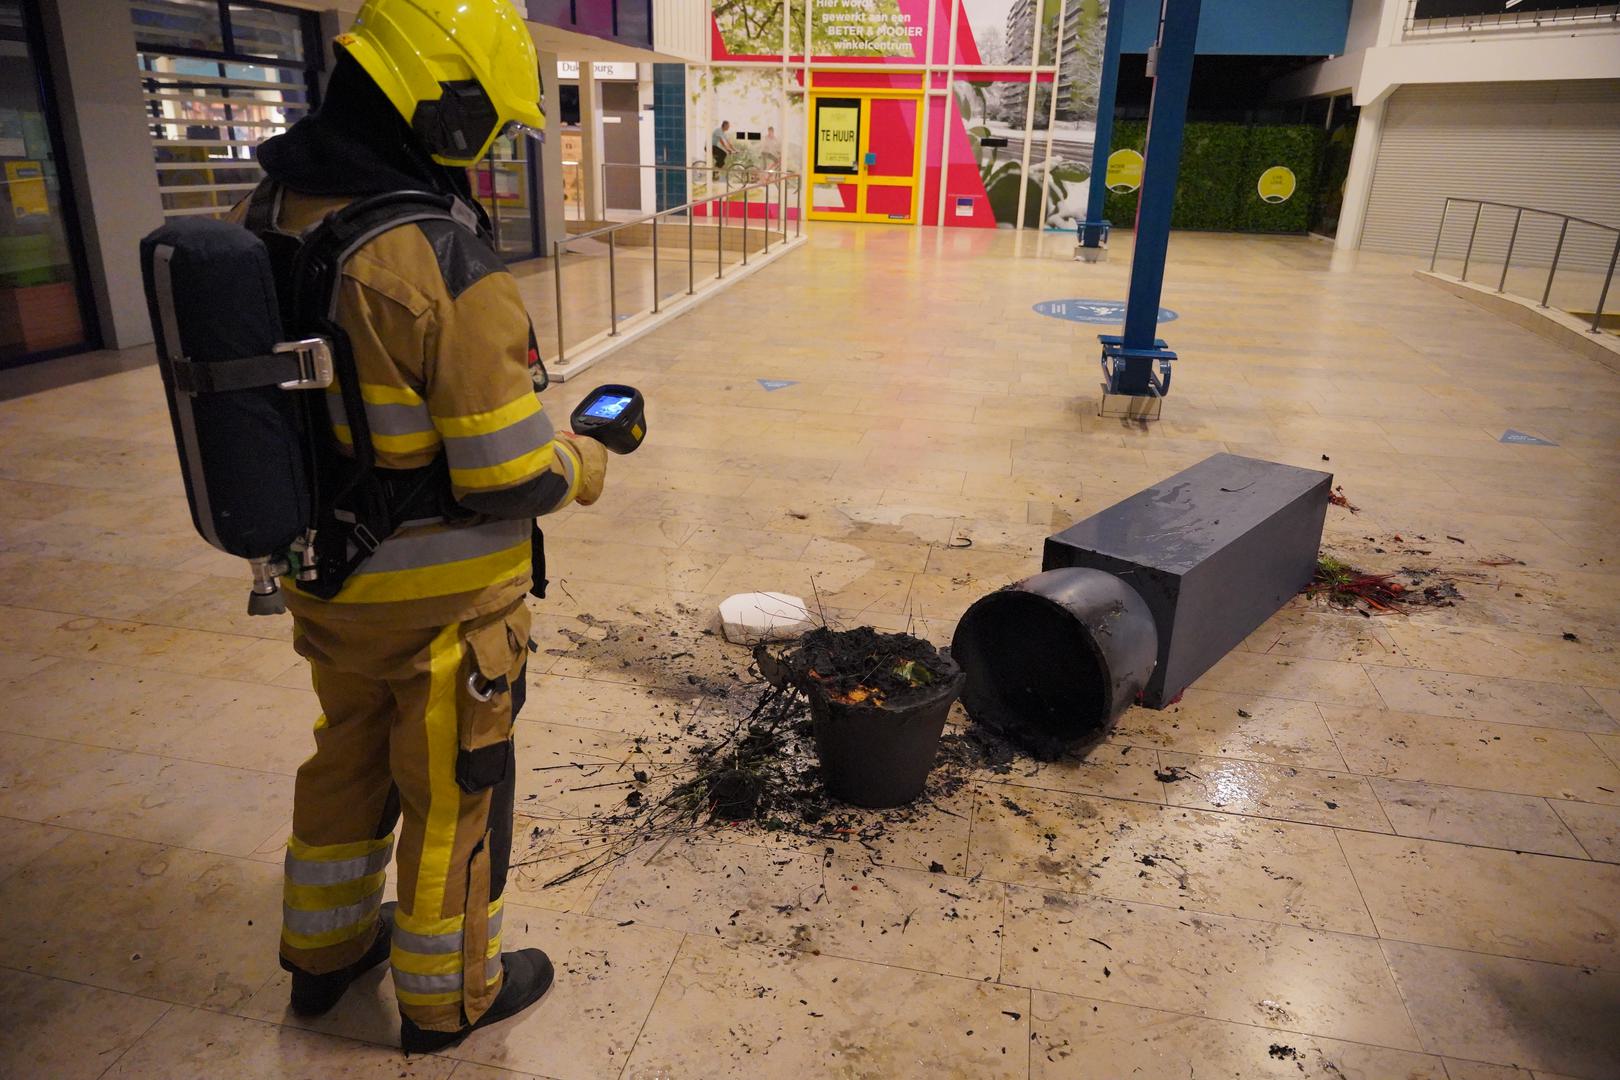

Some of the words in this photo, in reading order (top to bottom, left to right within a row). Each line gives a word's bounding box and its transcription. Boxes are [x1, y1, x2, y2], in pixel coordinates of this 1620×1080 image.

[822, 12, 866, 23] gewerkt
[868, 14, 888, 22] aan
[890, 14, 911, 22] een
[827, 26, 864, 36] BETER
[877, 26, 923, 37] MOOIER
[833, 39, 913, 50] winkelcentrum
[821, 129, 831, 142] TE
[832, 129, 855, 142] HUUR
